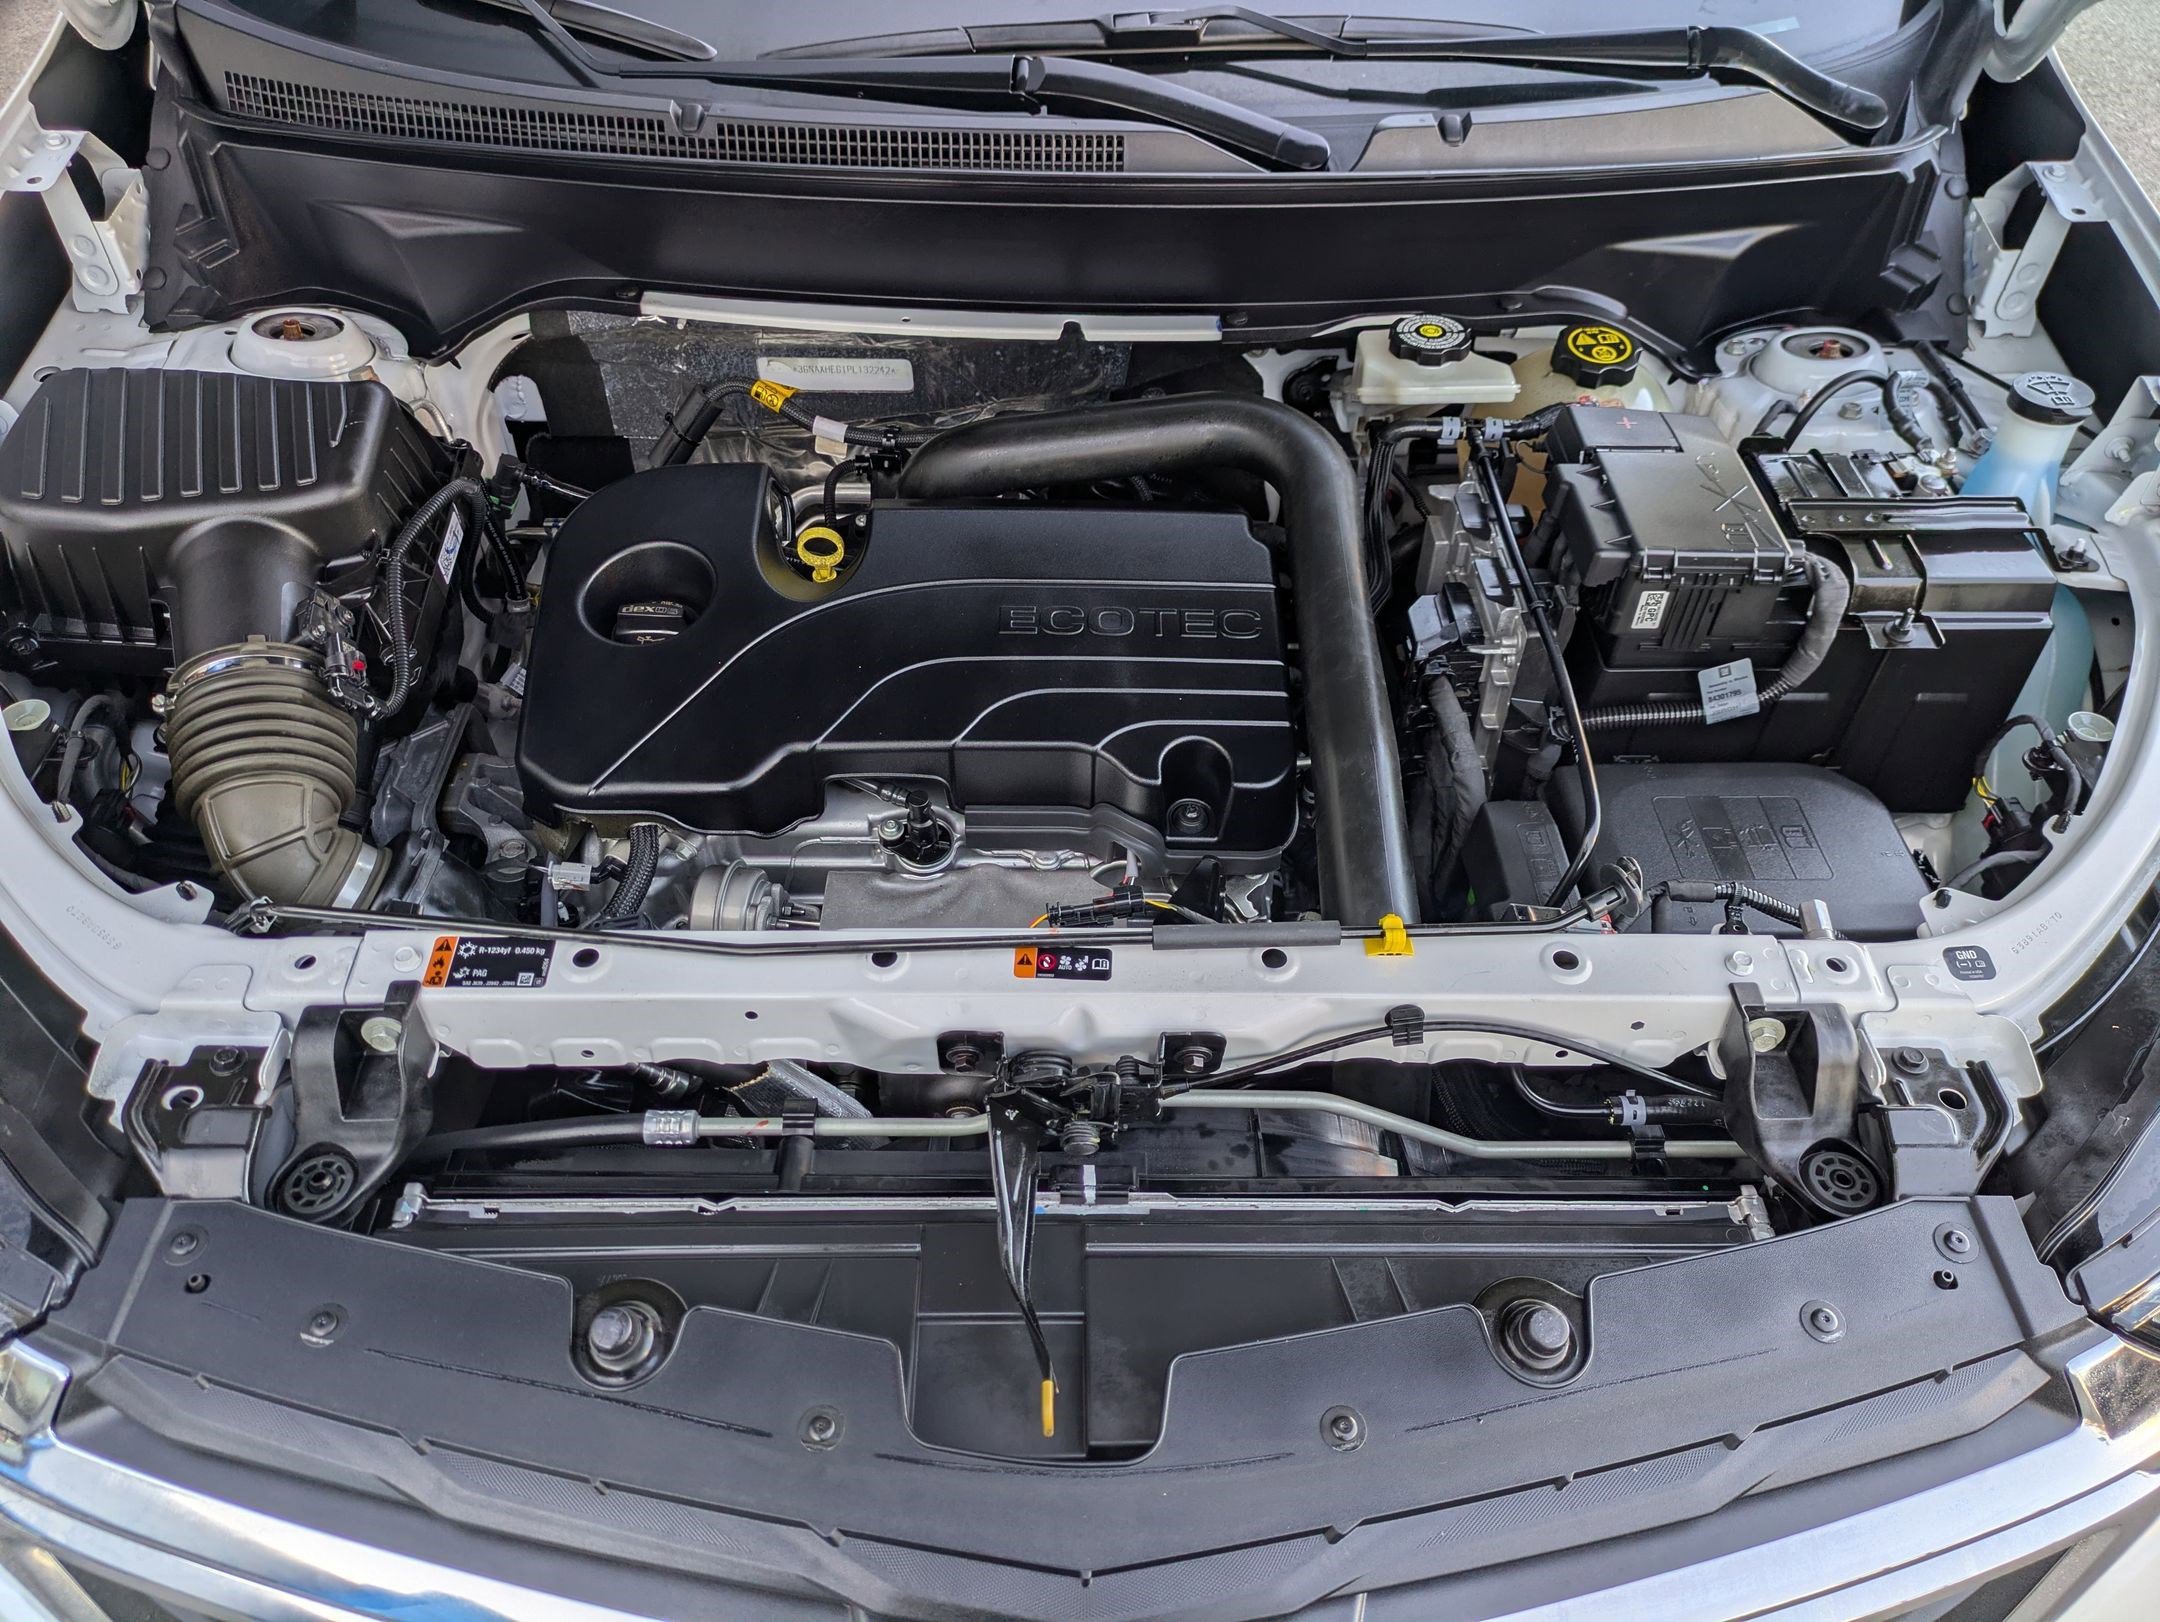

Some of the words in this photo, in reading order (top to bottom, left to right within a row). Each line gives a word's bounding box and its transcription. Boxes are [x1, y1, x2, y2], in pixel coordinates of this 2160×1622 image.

[998, 605, 1262, 639] ECOTEC
[514, 947, 535, 955] 0.450
[535, 947, 546, 956] kg
[1955, 949, 1978, 960] GND
[472, 969, 488, 977] PAG
